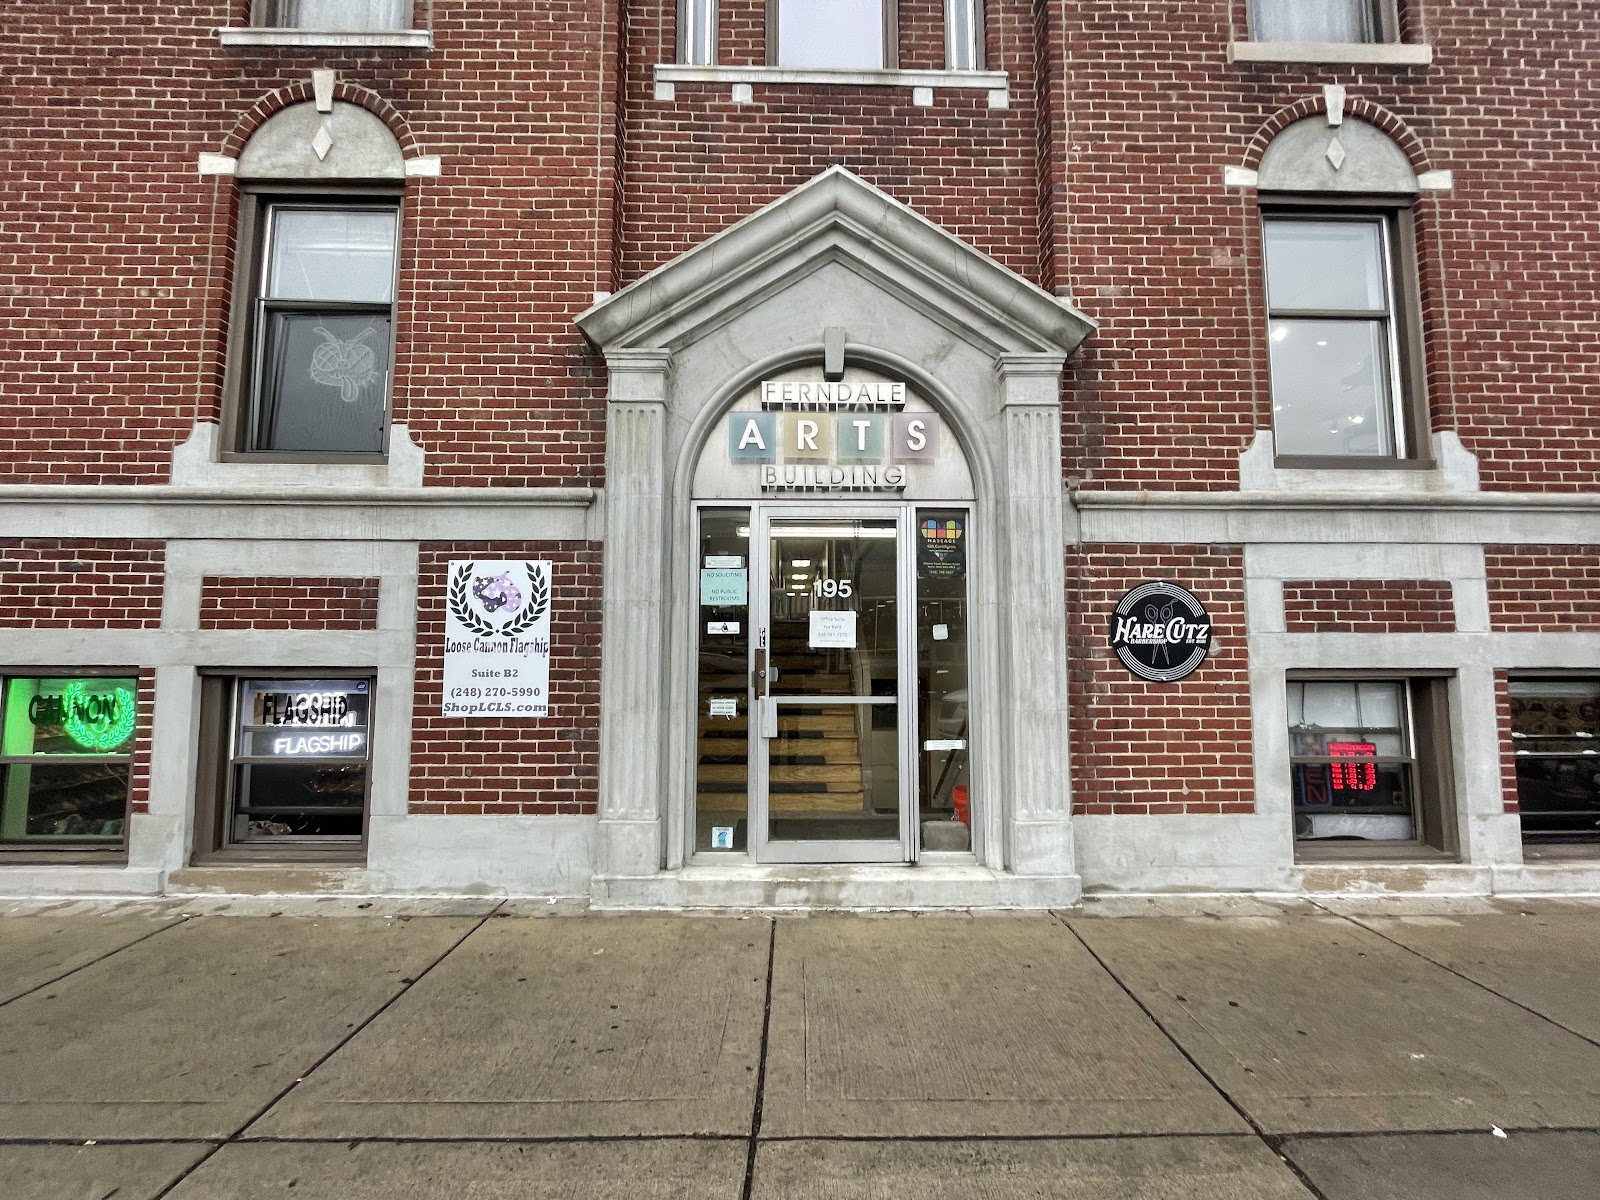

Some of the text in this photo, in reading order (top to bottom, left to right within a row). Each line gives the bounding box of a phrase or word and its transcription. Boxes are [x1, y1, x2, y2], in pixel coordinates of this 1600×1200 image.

[765, 382, 902, 402] FERNDALE
[738, 419, 926, 451] ARTS
[765, 466, 902, 485] BUILDING
[813, 579, 852, 598] 195
[445, 636, 549, 658] Loose Cannon Flagship
[471, 668, 519, 678] Suite B2
[450, 687, 541, 699] (248) 270-5990
[443, 702, 547, 715] ShopLCLS.com
[273, 733, 362, 755] FLAGSHIP
